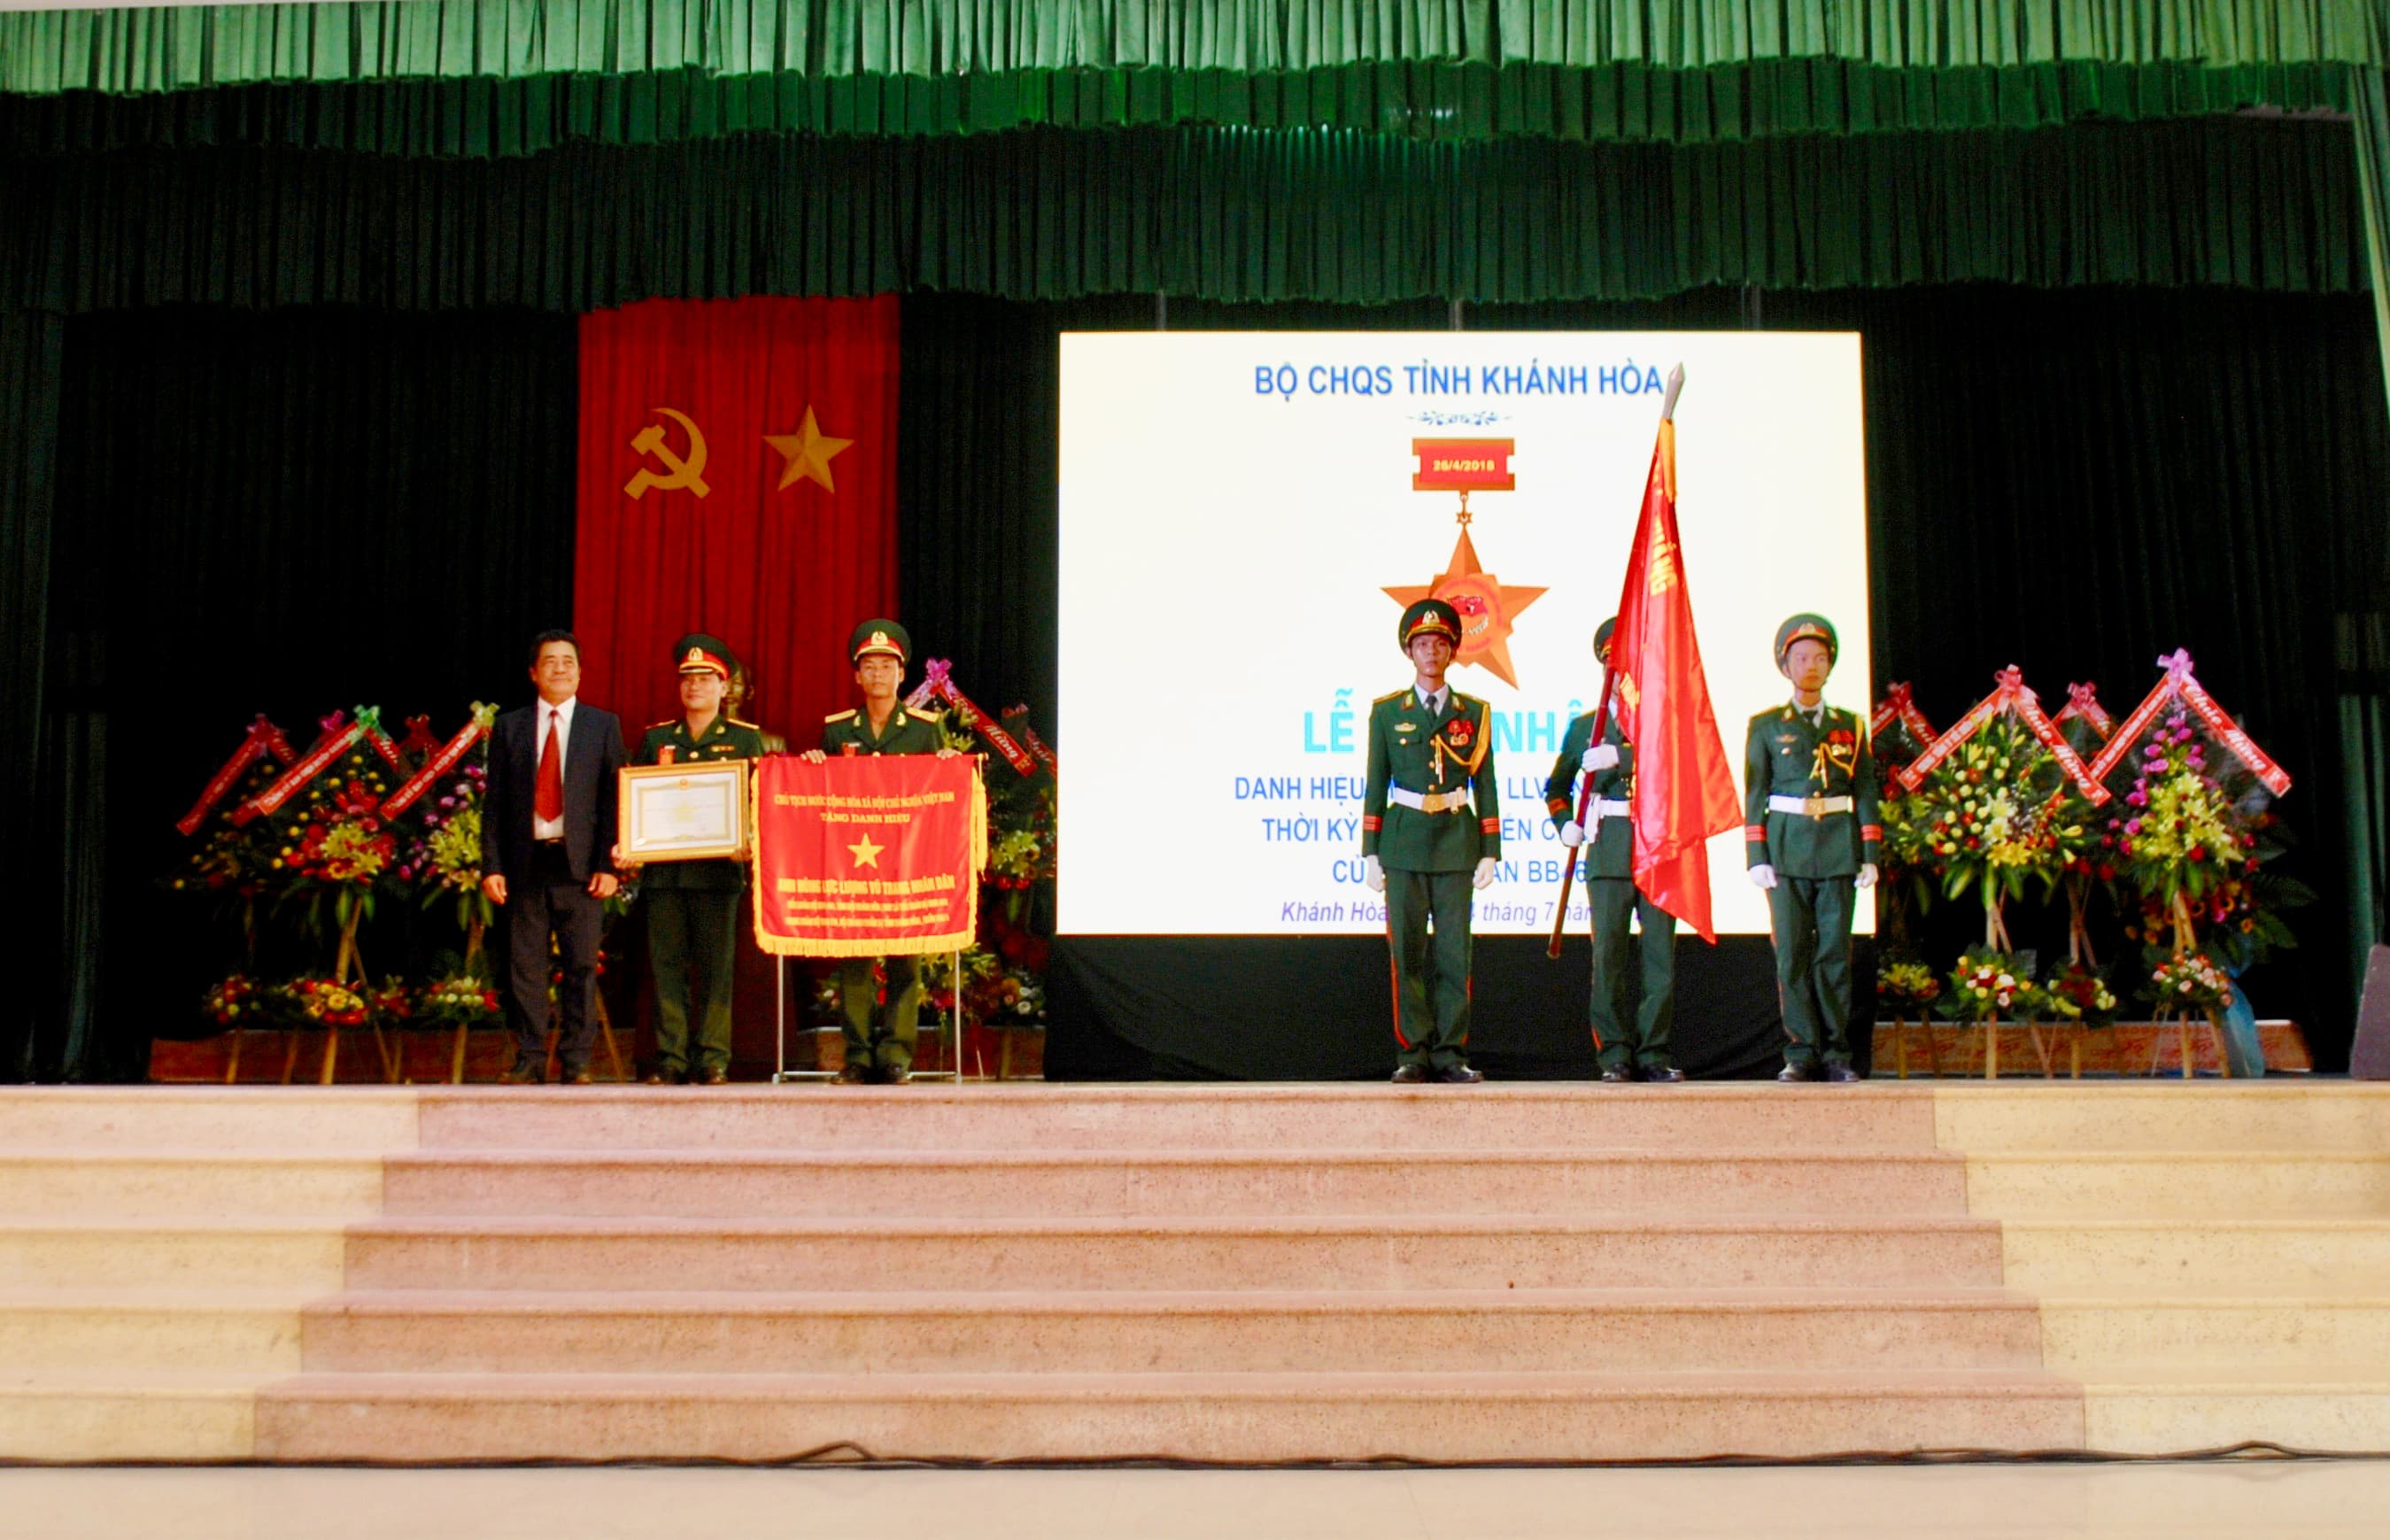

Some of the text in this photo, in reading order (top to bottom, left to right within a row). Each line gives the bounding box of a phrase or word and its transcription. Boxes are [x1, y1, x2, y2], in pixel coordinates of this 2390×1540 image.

[1255, 357, 1664, 402] BỘ CHQS TỈNH KHÁNH HÒA
[1303, 688, 1355, 753] LỄ
[1235, 776, 1302, 800] DANH
[1310, 773, 1365, 806] HIỆU
[1262, 812, 1358, 841] THỜI KỲ
[1281, 901, 1344, 922] Khánh
[1482, 901, 1537, 926] tháng
[1544, 902, 1555, 921] 7
